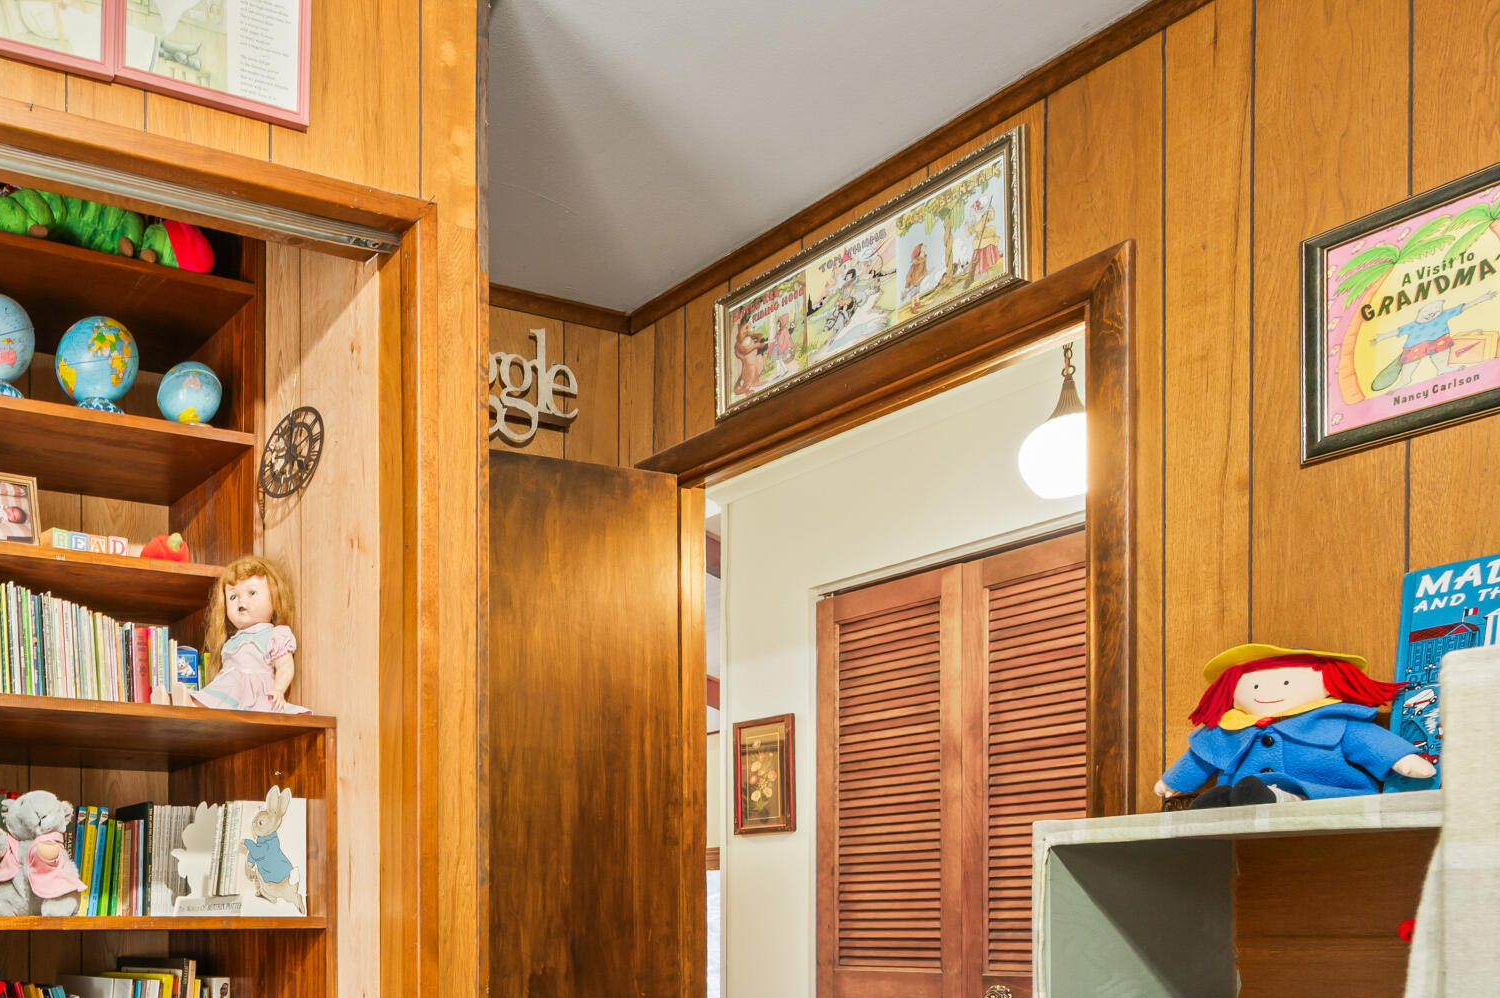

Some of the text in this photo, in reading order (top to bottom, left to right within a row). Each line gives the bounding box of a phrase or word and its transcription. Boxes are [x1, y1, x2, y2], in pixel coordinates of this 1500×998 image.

[818, 228, 888, 273] TOM THUMB
[1401, 250, 1475, 287] A Visit To
[751, 286, 806, 324] RIDING HOOD
[1393, 371, 1480, 407] Nancy Carlson
[55, 530, 127, 556] READ
[1413, 594, 1467, 613] AND
